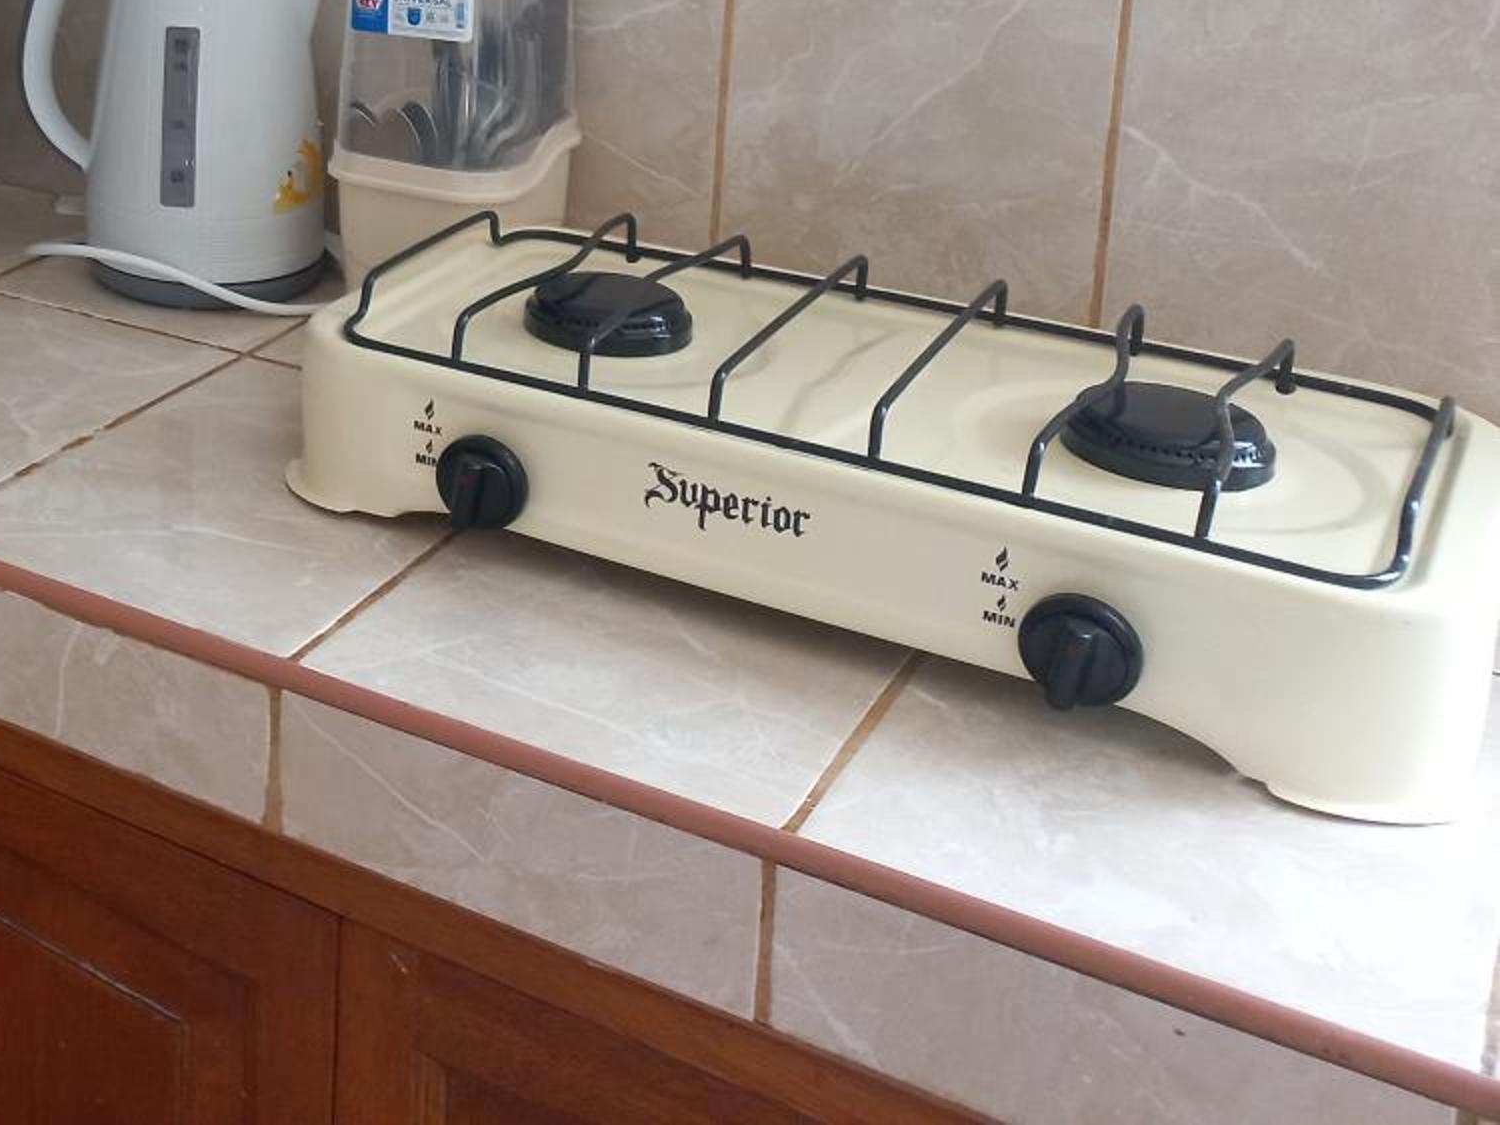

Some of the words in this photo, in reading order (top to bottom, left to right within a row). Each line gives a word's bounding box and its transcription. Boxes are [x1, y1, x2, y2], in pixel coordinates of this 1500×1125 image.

[414, 420, 443, 436] MAX
[644, 462, 812, 539] Superior
[981, 571, 1019, 591] MAX
[982, 610, 1016, 628] MIN
